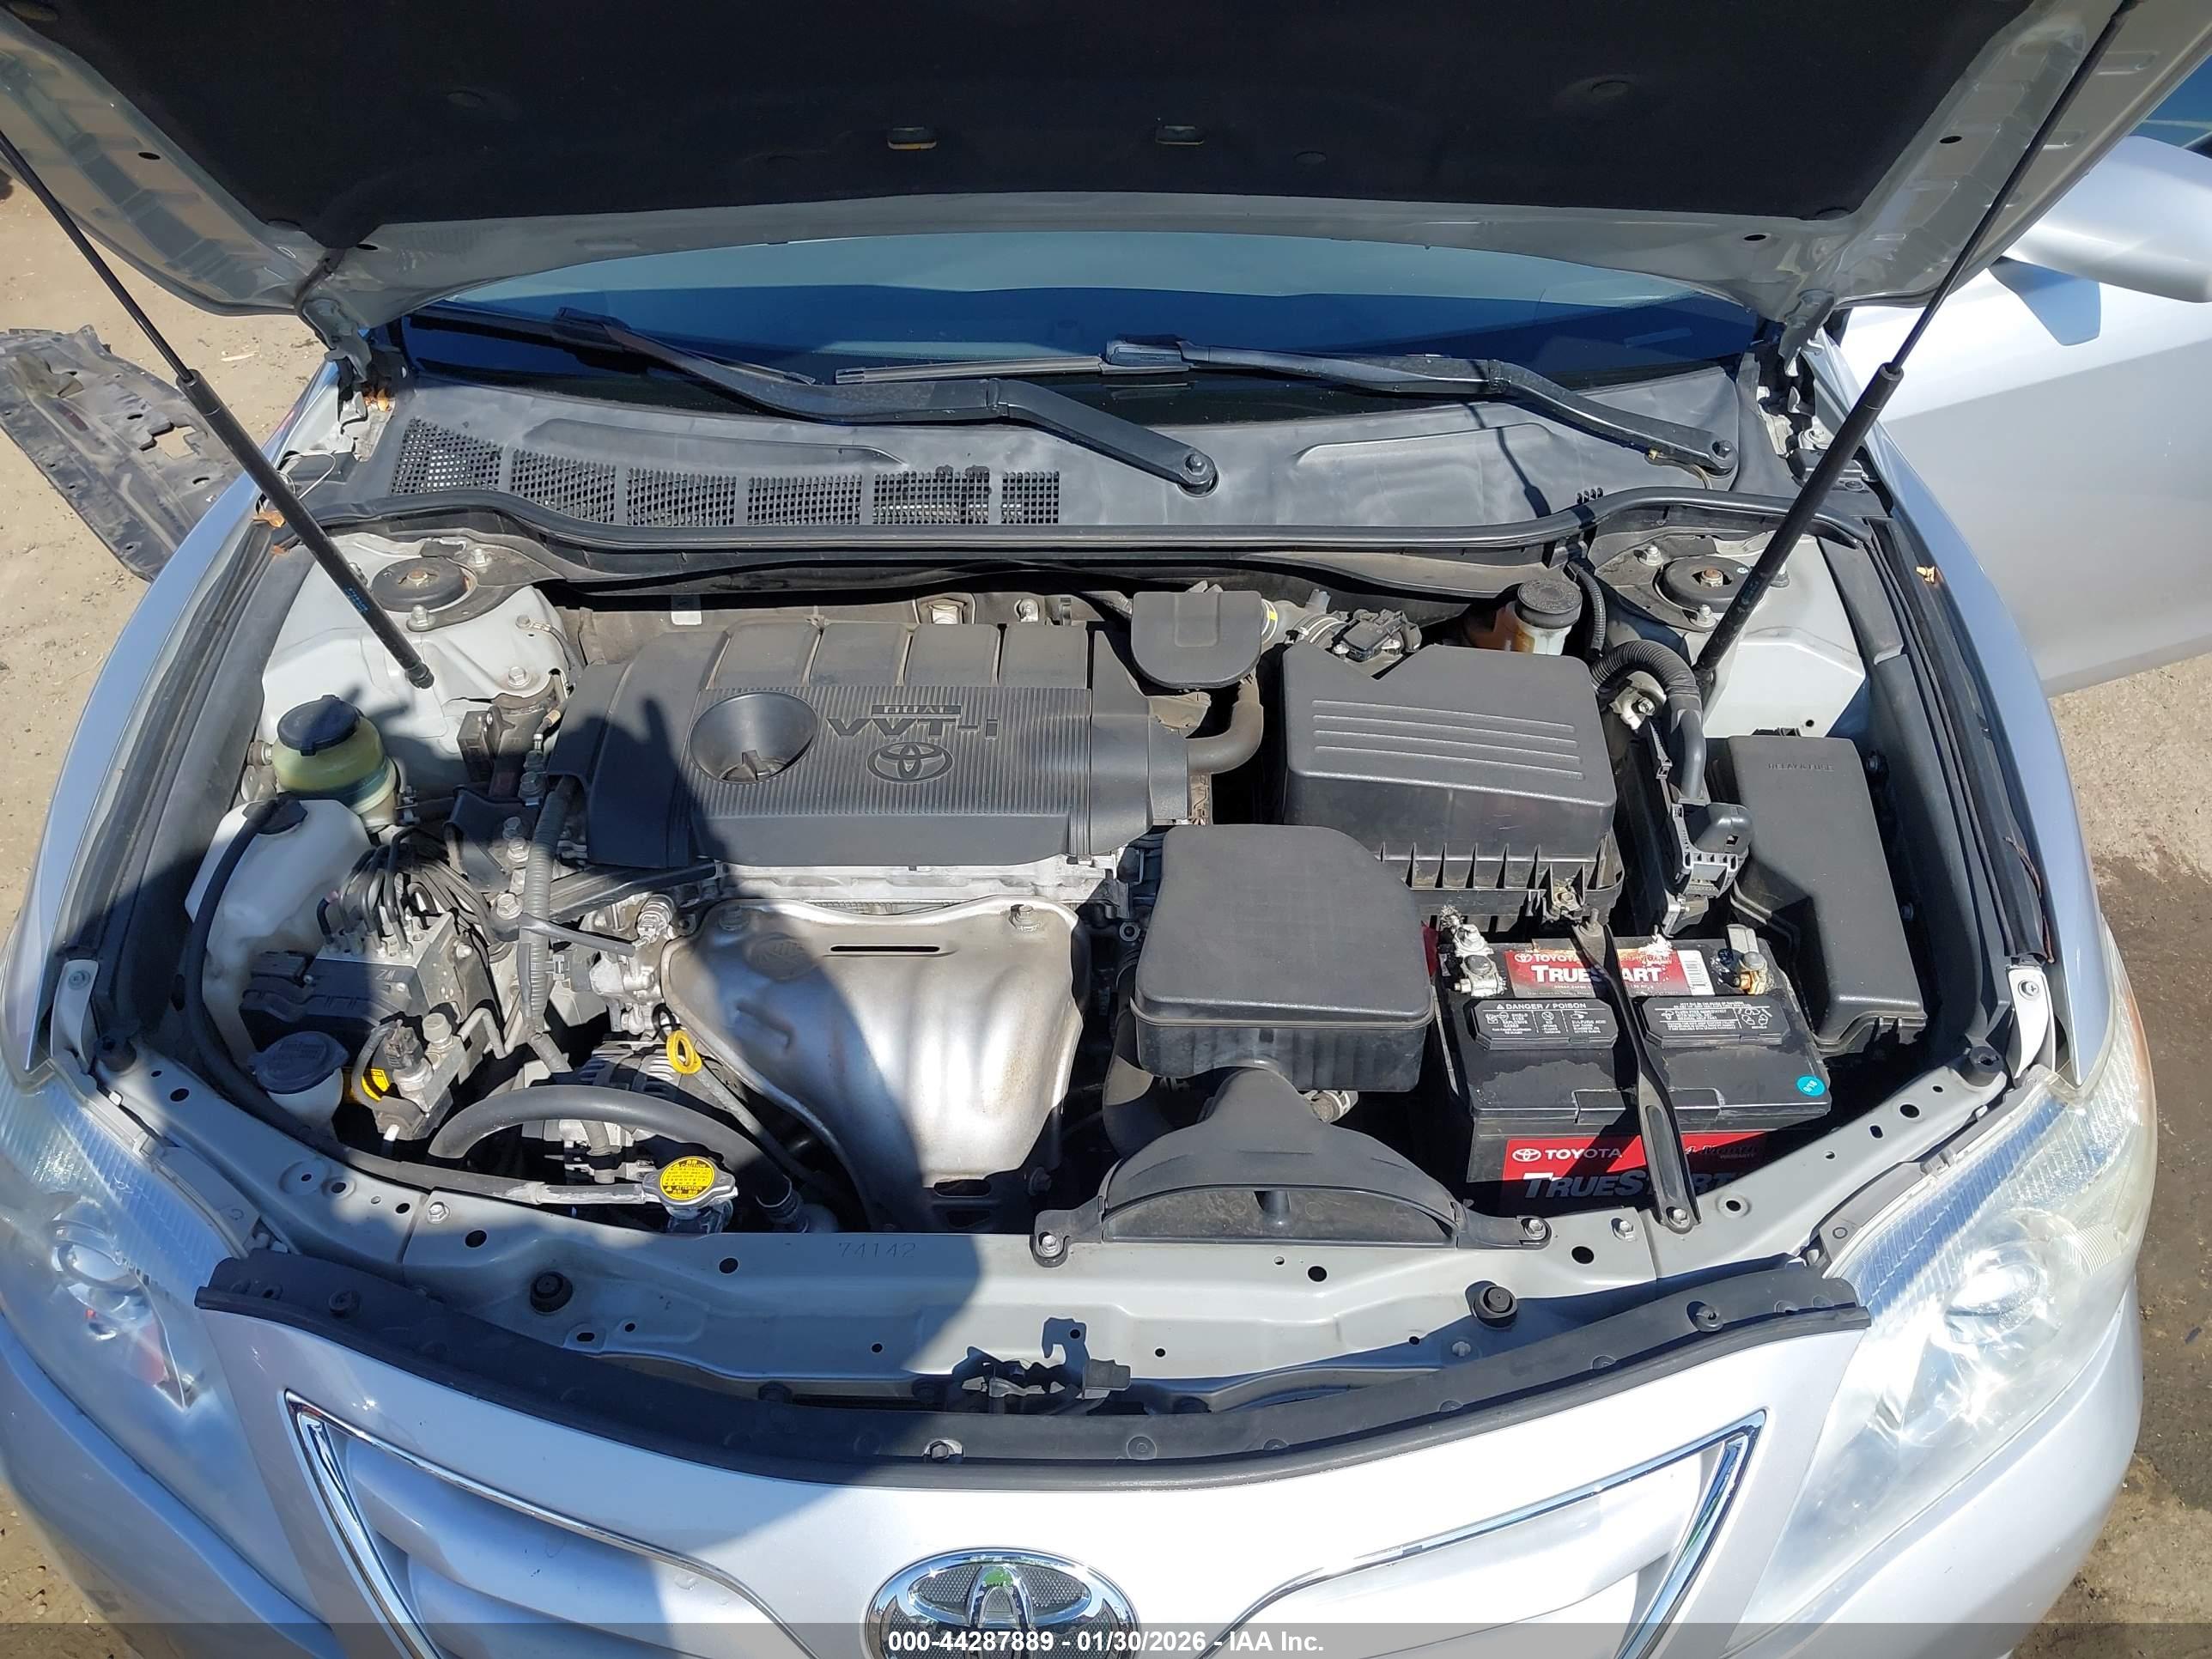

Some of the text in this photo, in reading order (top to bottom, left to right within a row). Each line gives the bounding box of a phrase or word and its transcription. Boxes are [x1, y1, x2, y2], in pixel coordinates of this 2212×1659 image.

[883, 705, 951, 714] DUAL
[1544, 1147, 1623, 1160] TOYOTA
[838, 1242, 916, 1258] 74142
